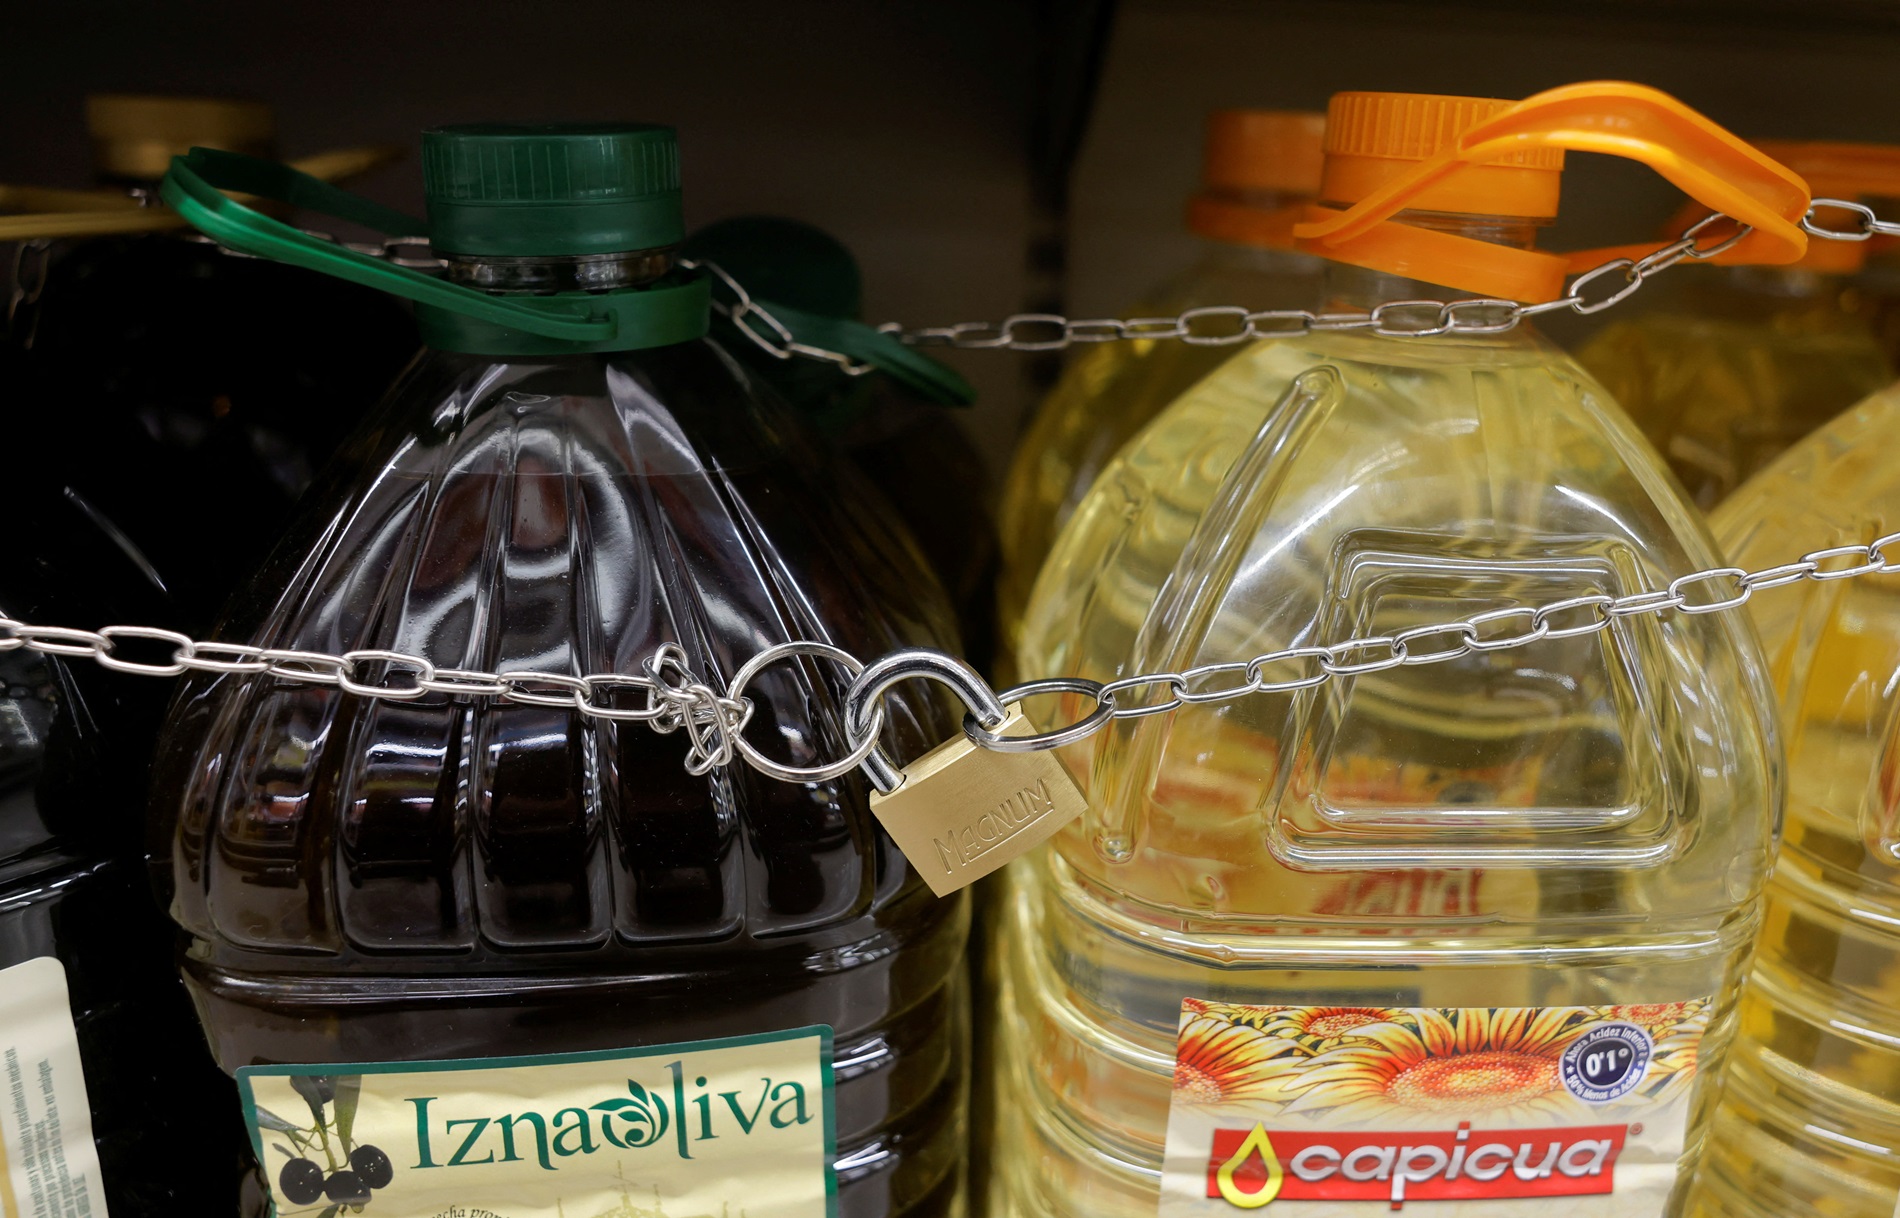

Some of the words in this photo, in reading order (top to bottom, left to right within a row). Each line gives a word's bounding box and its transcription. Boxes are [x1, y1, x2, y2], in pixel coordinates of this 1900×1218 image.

[932, 777, 1052, 875] MAGNUM
[1565, 1039, 1589, 1063] Ahora
[1589, 1027, 1621, 1042] Acidez
[1621, 1027, 1648, 1053] Inferior
[1566, 1073, 1586, 1096] 50%
[1581, 1089, 1609, 1101] Menos
[1609, 1087, 1621, 1098] de
[1290, 1122, 1613, 1210] capicua
